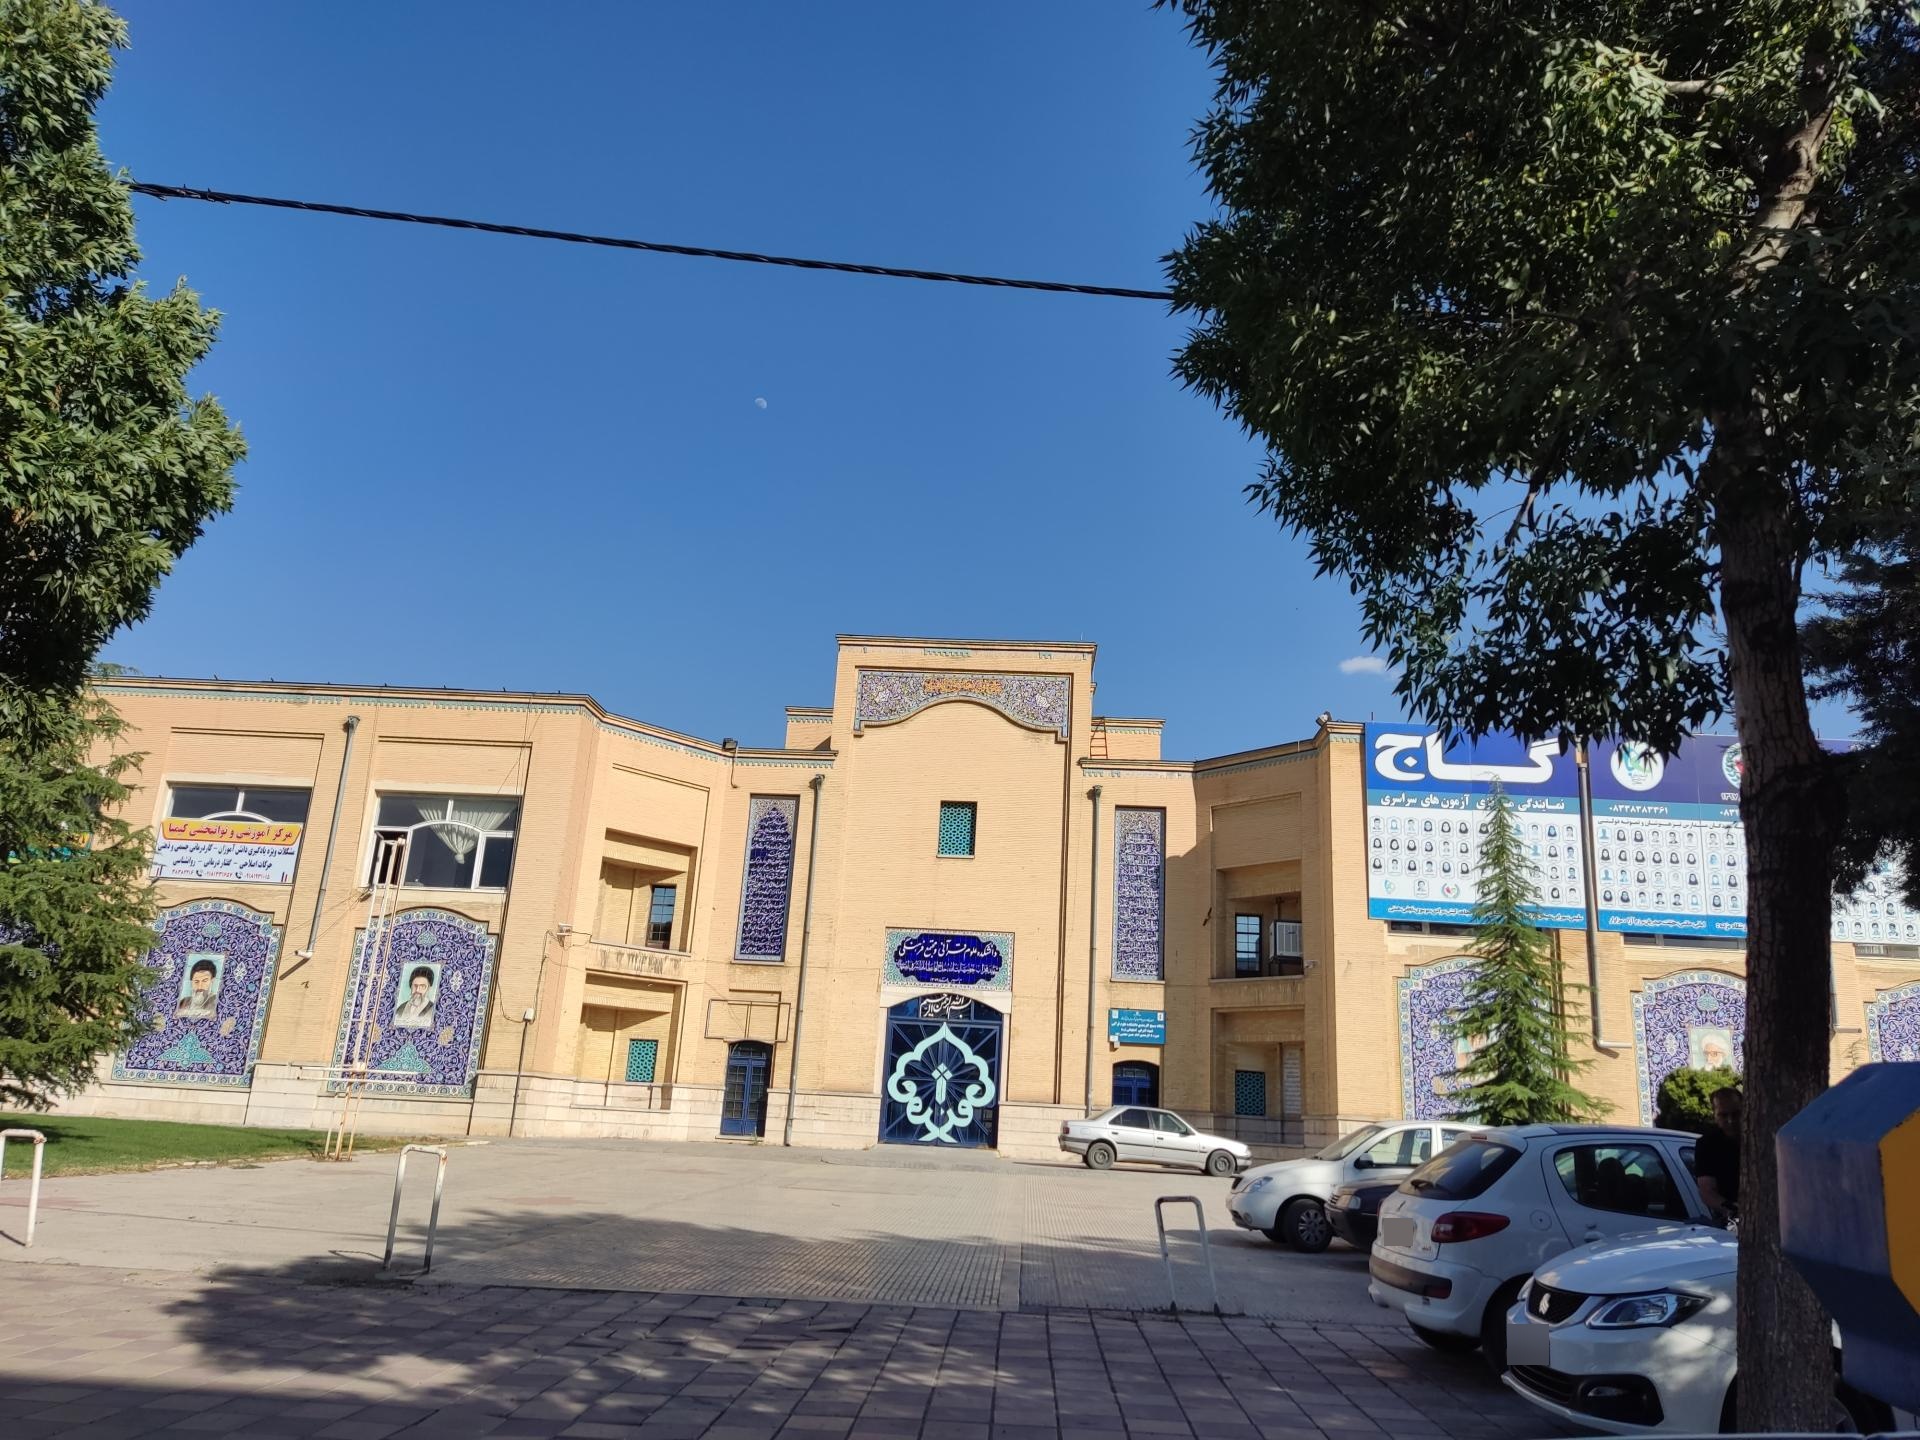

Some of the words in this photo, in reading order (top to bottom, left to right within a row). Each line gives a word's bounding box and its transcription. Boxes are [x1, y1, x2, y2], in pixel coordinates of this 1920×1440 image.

[1374, 731, 1561, 783] گاج
[1380, 791, 1418, 807] سراسری
[1420, 793, 1440, 808] های
[1440, 793, 1470, 810] آزمون
[1517, 797, 1565, 812] نمایندگی
[236, 825, 271, 840] آموزشی
[274, 827, 293, 841] مرکز
[898, 937, 926, 957] فرهنگی
[937, 939, 967, 957] قرآنی
[963, 946, 977, 960] علوم
[976, 941, 998, 958] دانشکده
